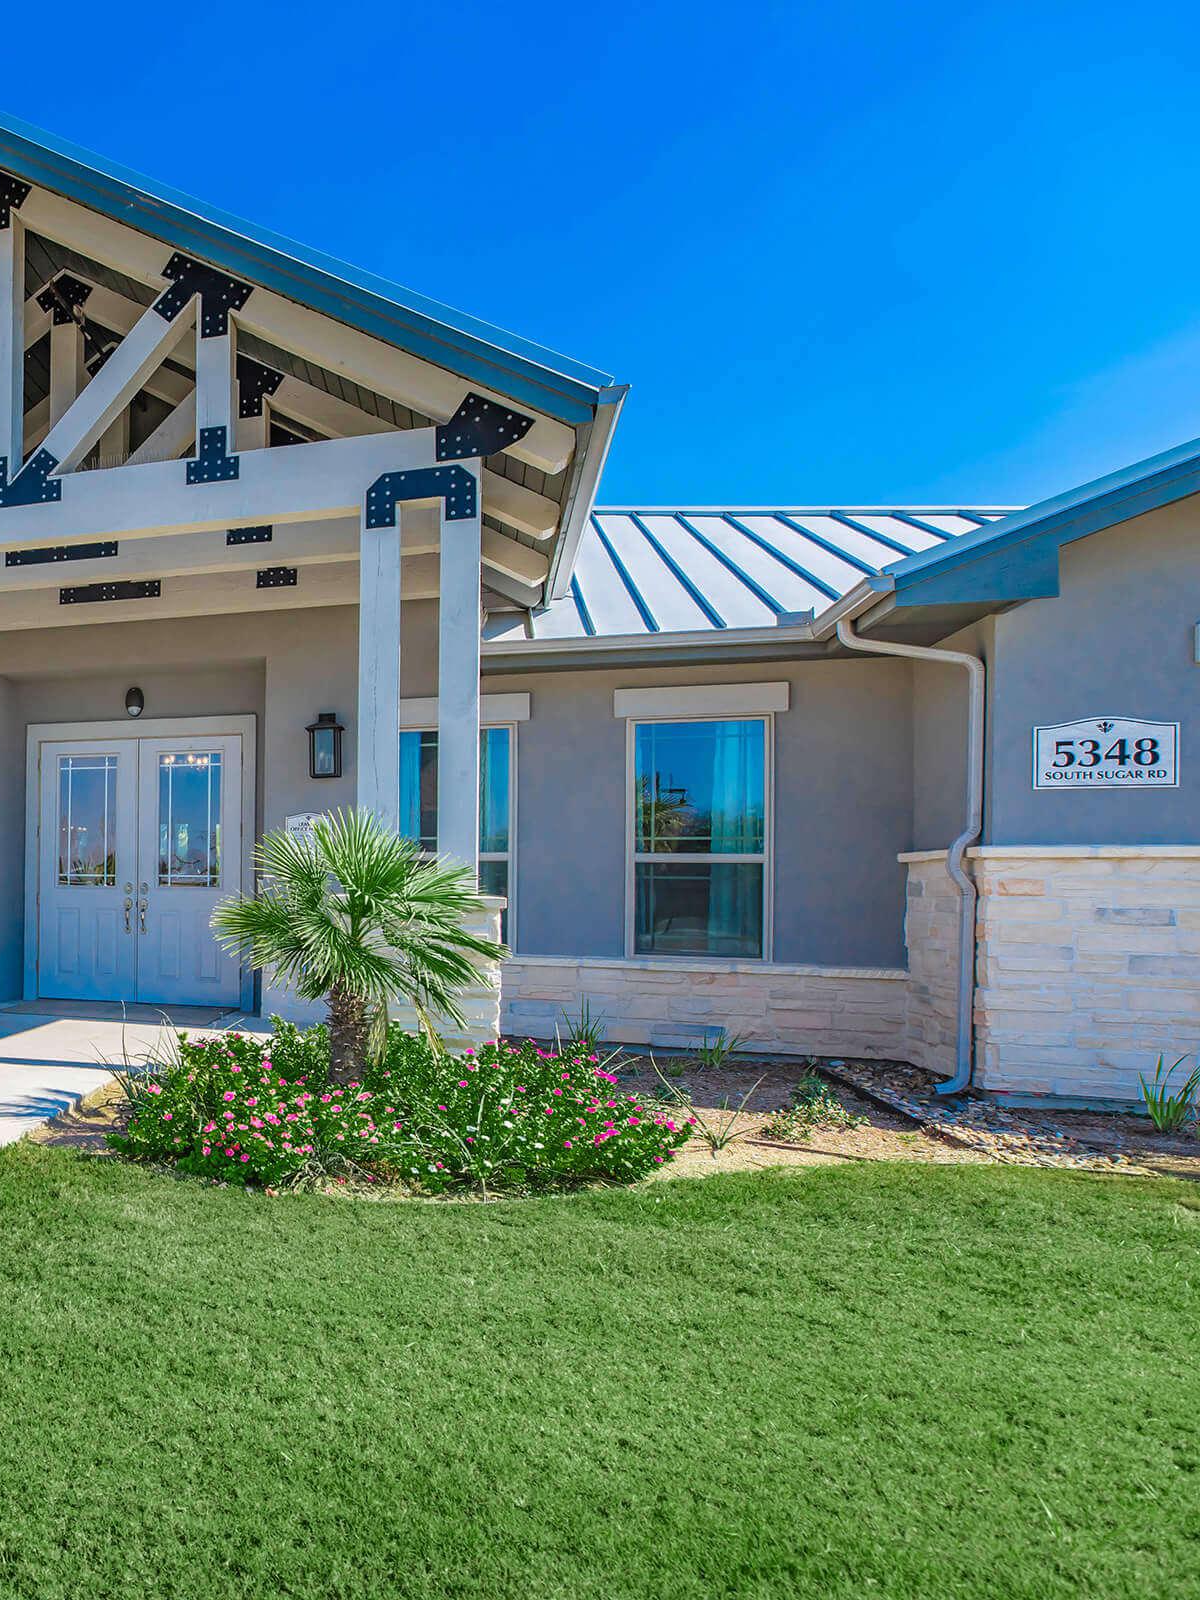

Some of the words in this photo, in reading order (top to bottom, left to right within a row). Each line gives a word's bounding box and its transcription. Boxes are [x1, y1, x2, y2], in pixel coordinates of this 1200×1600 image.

[1052, 738, 1160, 768] 5348
[1044, 771, 1093, 780] SOUTH
[1097, 769, 1143, 780] SUGAR
[1147, 769, 1167, 779] RD
